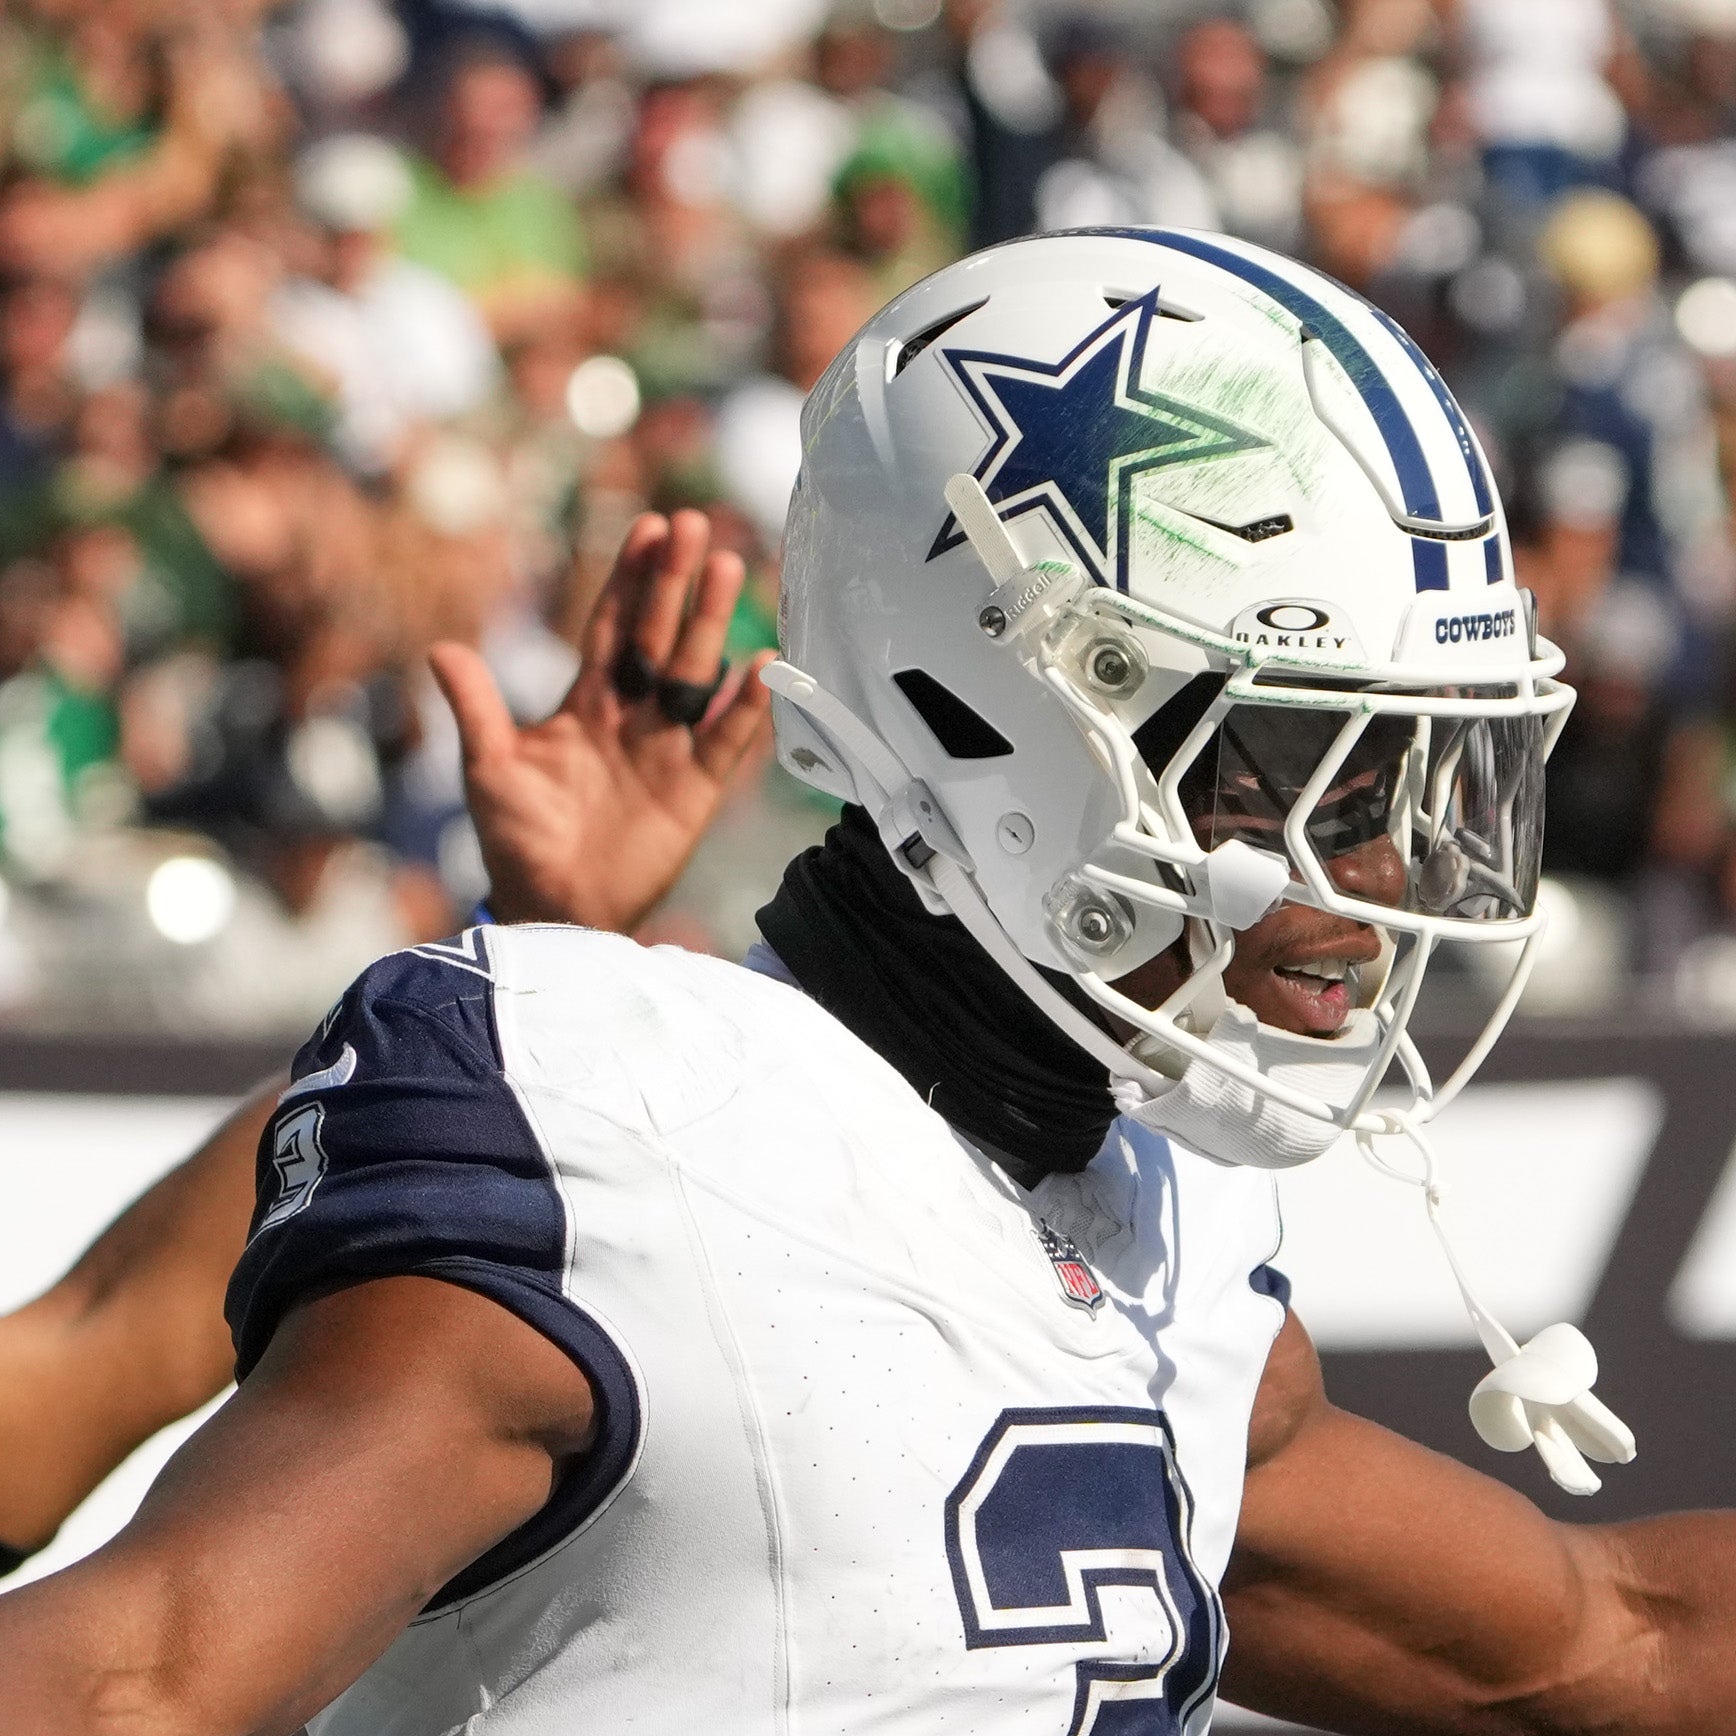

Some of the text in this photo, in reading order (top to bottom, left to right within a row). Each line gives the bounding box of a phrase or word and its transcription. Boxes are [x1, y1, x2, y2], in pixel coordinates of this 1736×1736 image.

[1235, 631, 1346, 649] OAKLEY
[1435, 609, 1516, 645] COWBOYS
[1057, 1262, 1100, 1300] NFL
